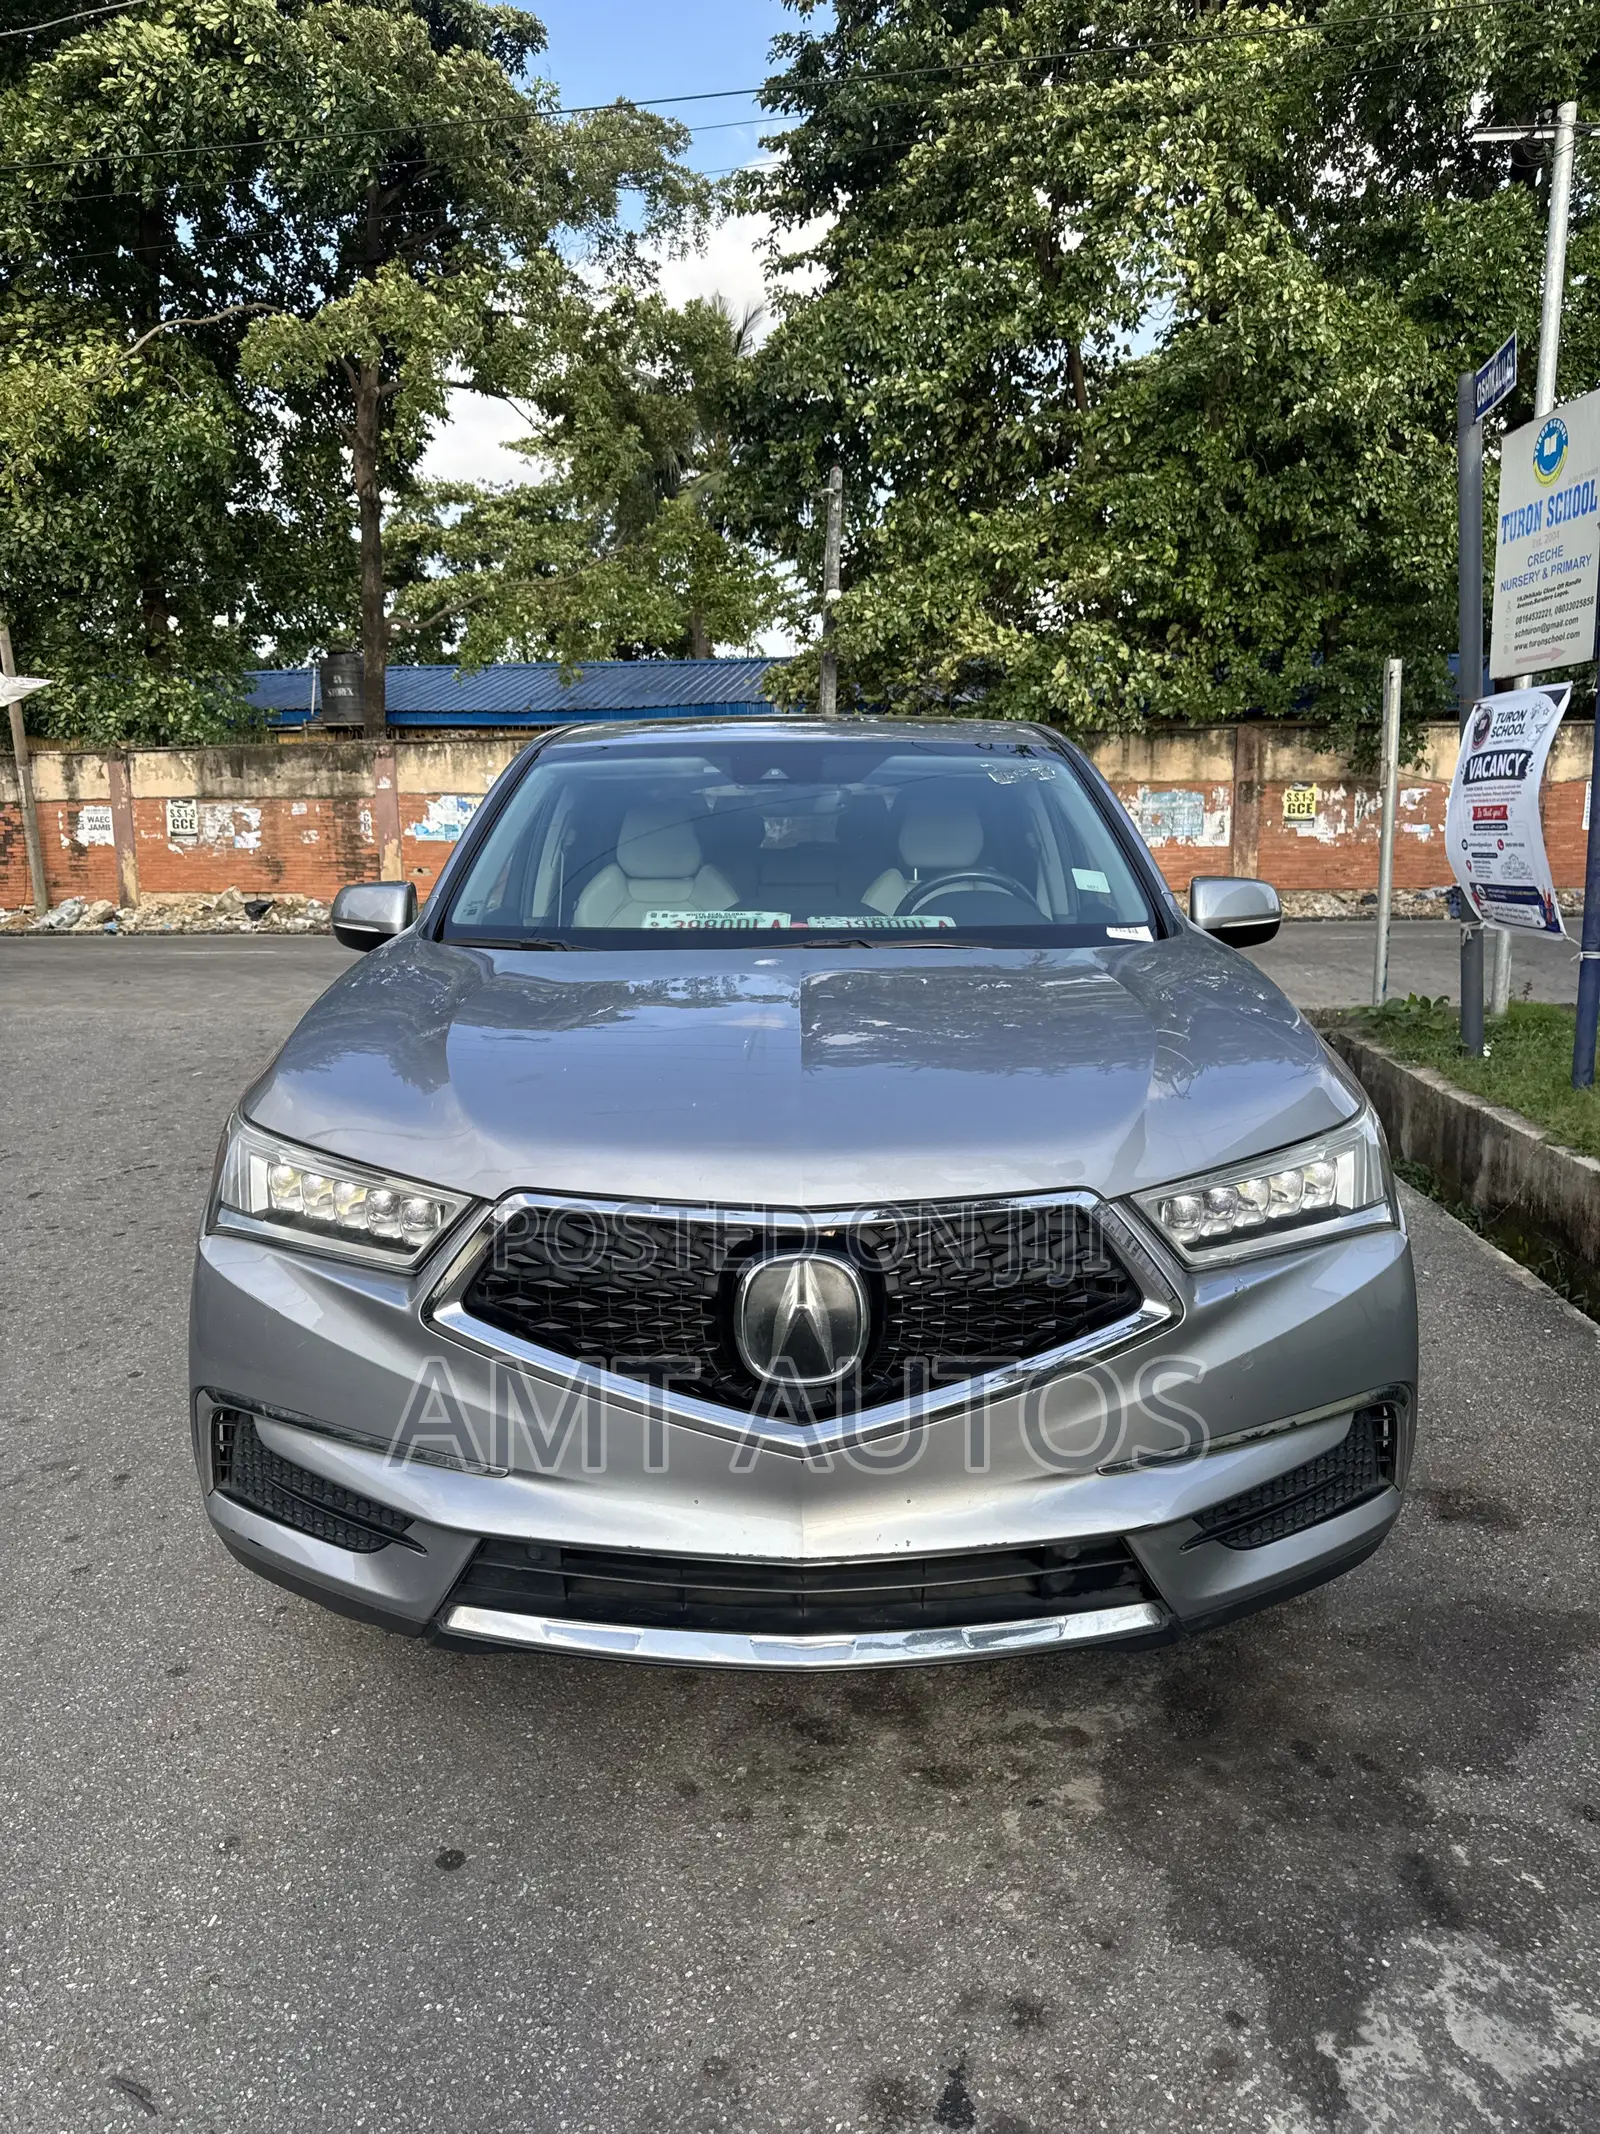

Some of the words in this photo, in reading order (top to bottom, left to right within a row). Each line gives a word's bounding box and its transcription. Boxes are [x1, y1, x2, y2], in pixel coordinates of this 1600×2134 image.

[1501, 500, 1543, 545] TURON
[1546, 479, 1598, 528] SCHOOL
[1527, 545, 1563, 568] CRECHE
[1500, 569, 1541, 592] NURSERY
[1542, 567, 1548, 580] &
[1550, 553, 1592, 577] PRIMARY
[1496, 709, 1527, 724] TURON
[1491, 723, 1526, 738] SCHOOL
[1469, 752, 1527, 780] VACANCY
[1287, 803, 1313, 814] GCE
[172, 818, 196, 829] GCE
